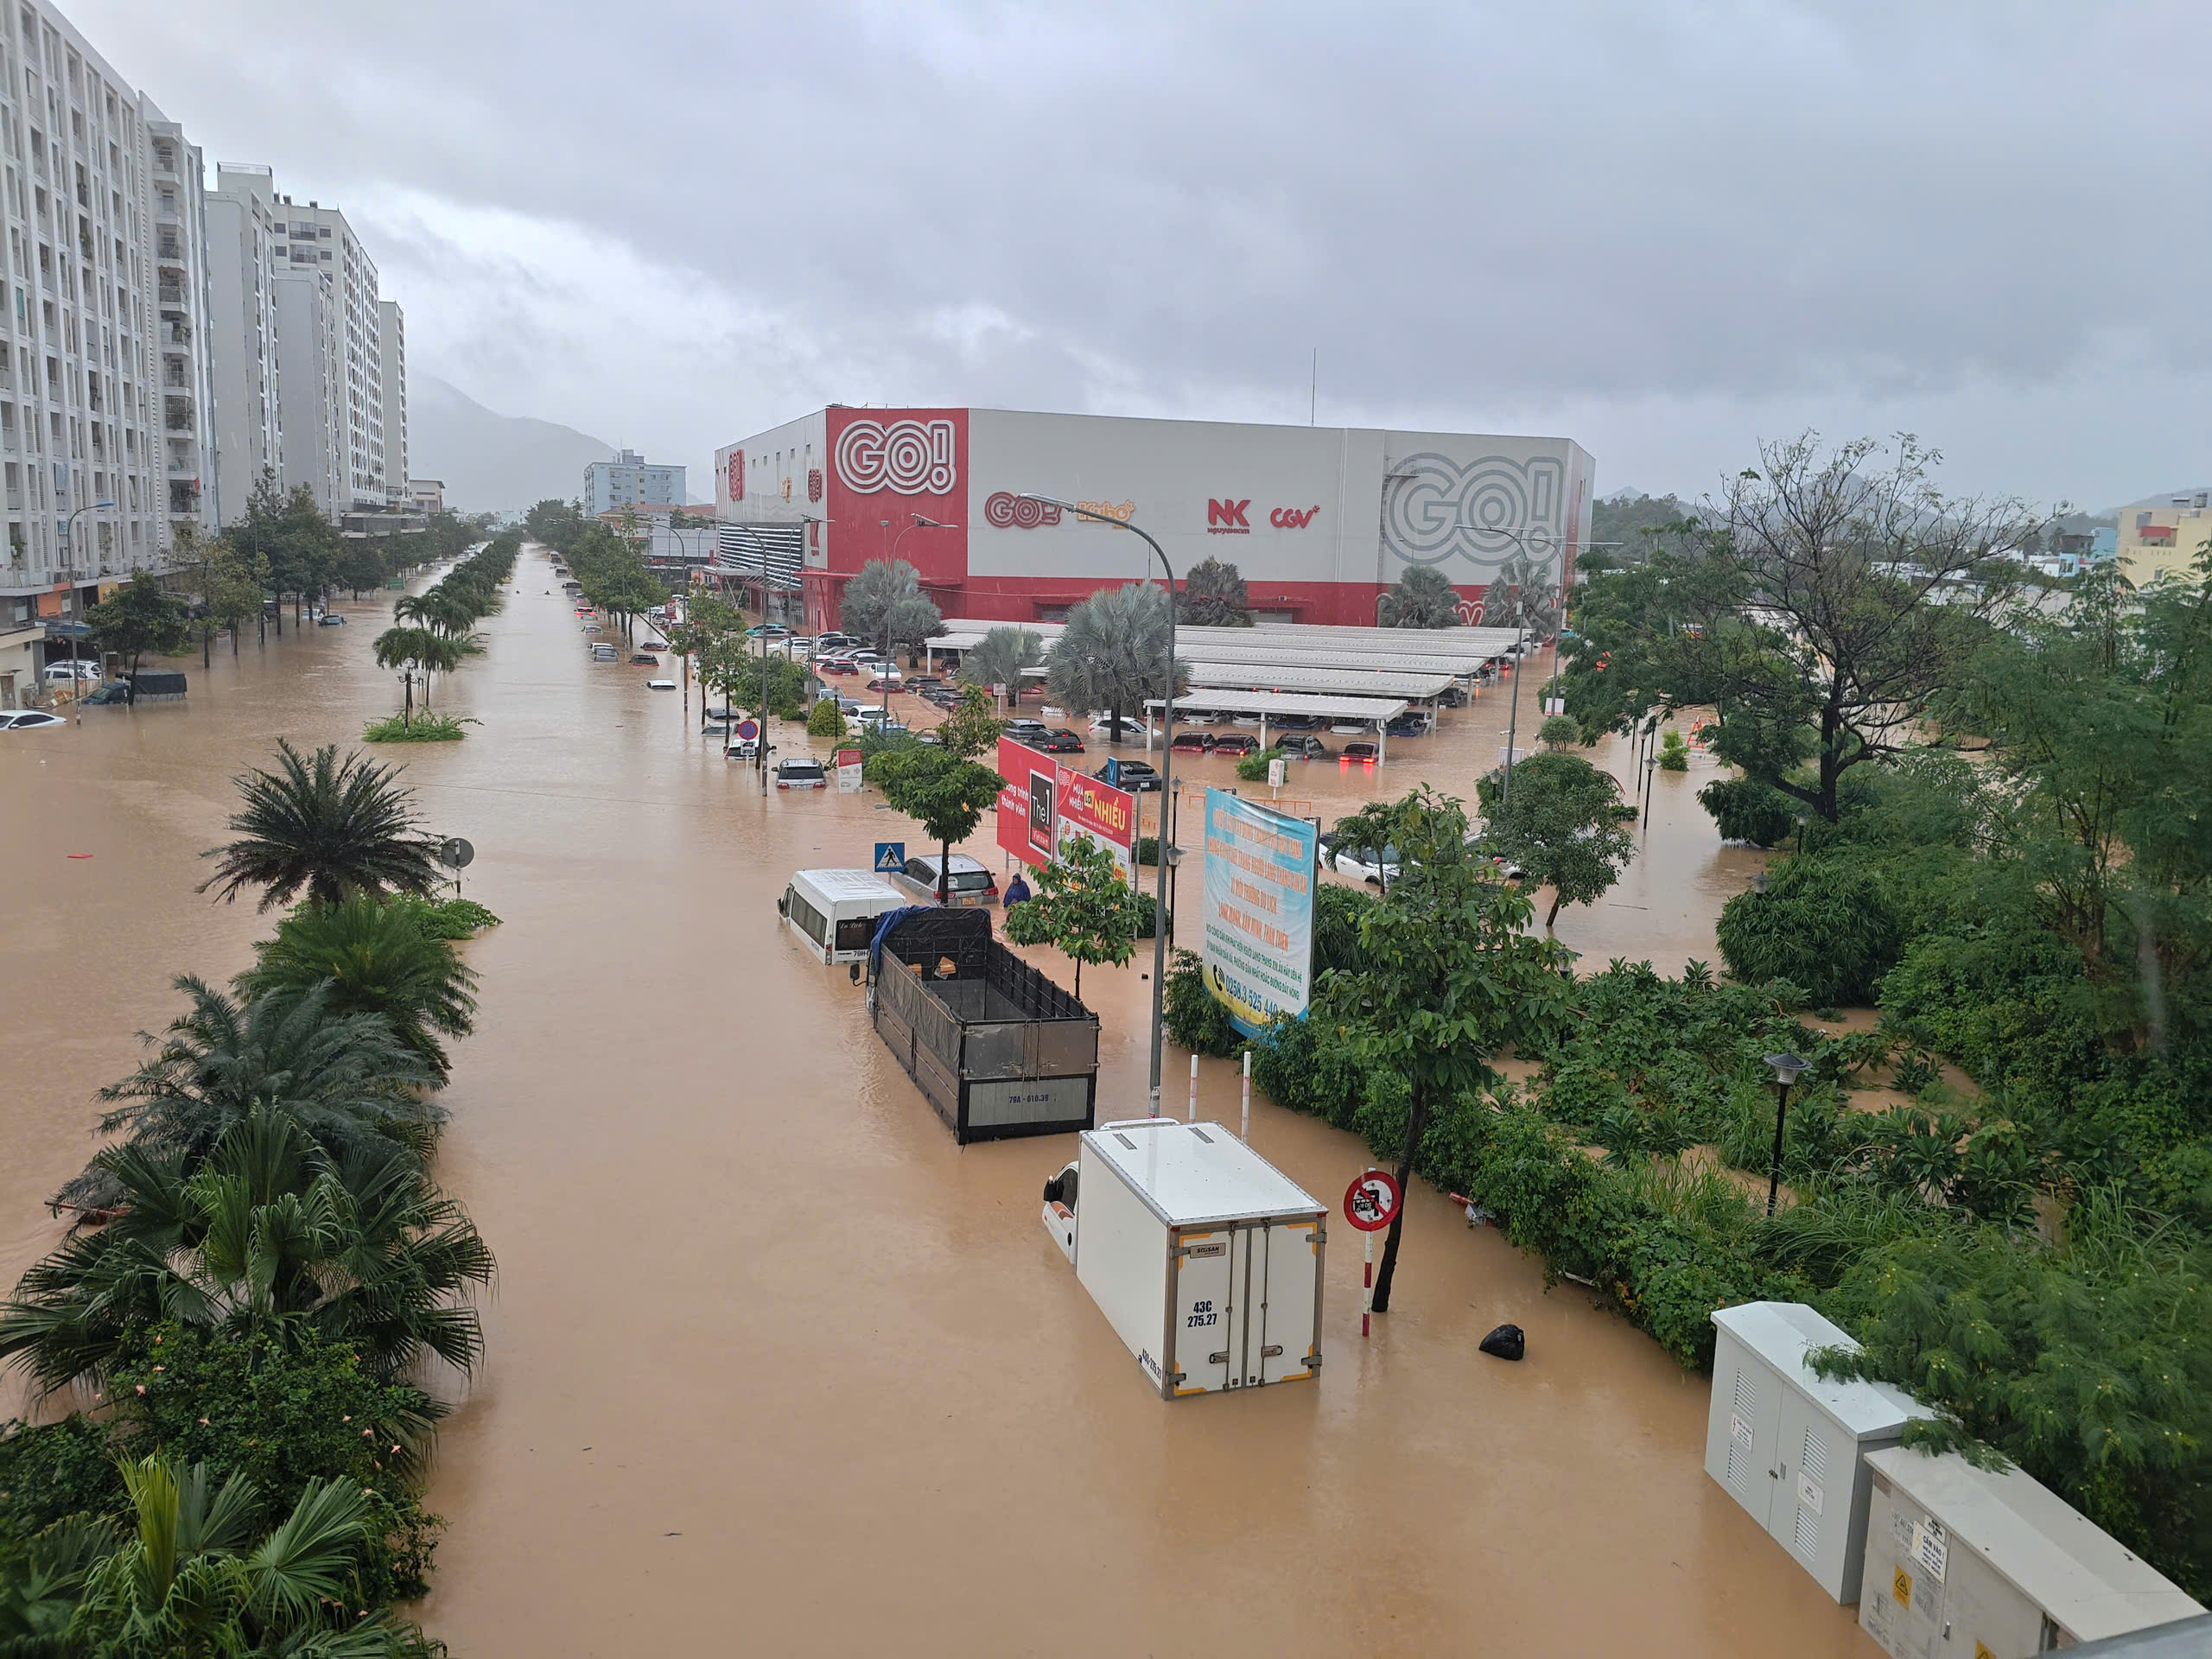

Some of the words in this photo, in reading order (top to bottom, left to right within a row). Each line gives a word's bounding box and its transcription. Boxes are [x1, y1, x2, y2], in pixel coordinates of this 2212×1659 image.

[835, 419, 957, 495] GO!
[1208, 499, 1251, 526] NK
[1270, 507, 1313, 529] CGV
[1382, 452, 1564, 566] GO!
[1072, 782, 1084, 797] MUA
[1094, 797, 1126, 831] NHIỀU
[1226, 975, 1247, 1003] 0258.3
[1249, 989, 1262, 1013] 525
[1187, 1313, 1217, 1327] 275.27
[1193, 1300, 1212, 1313] 43C
